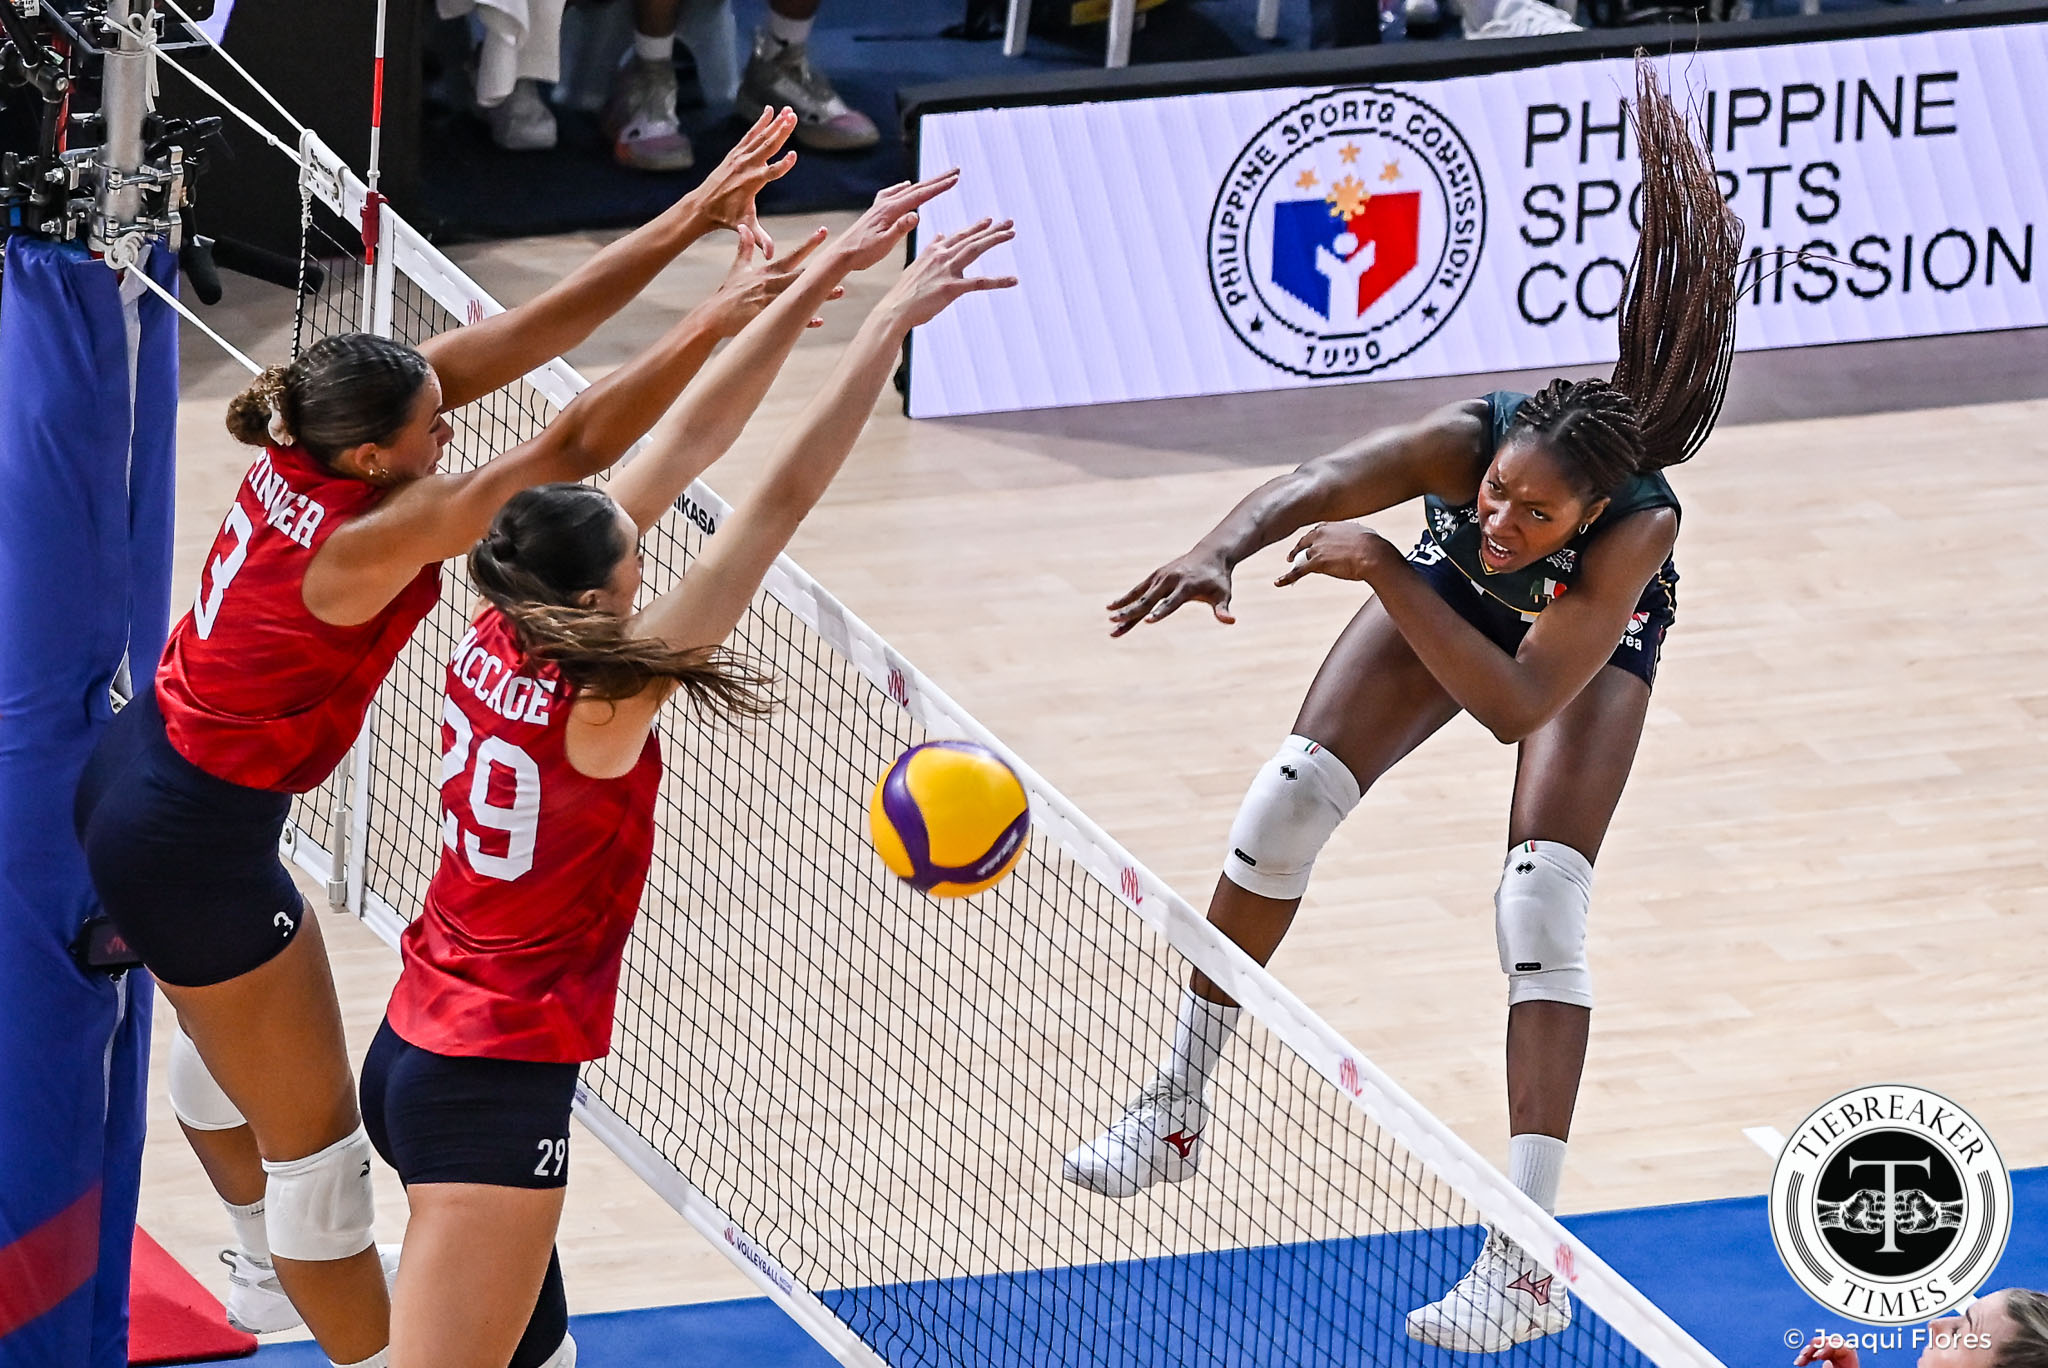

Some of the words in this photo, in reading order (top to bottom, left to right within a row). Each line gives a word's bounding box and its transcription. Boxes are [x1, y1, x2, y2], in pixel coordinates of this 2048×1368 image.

[1525, 71, 1958, 168] PHIPPINE
[1520, 161, 1841, 248] SPTS
[1517, 223, 2033, 327] COISSION
[674, 493, 716, 536] IKASA
[193, 501, 254, 641] 3
[440, 694, 541, 882] 29
[1121, 866, 1143, 905] VNL
[273, 911, 294, 938] 3
[534, 1138, 566, 1176] 29
[737, 1236, 779, 1286] VOLLEYBALL
